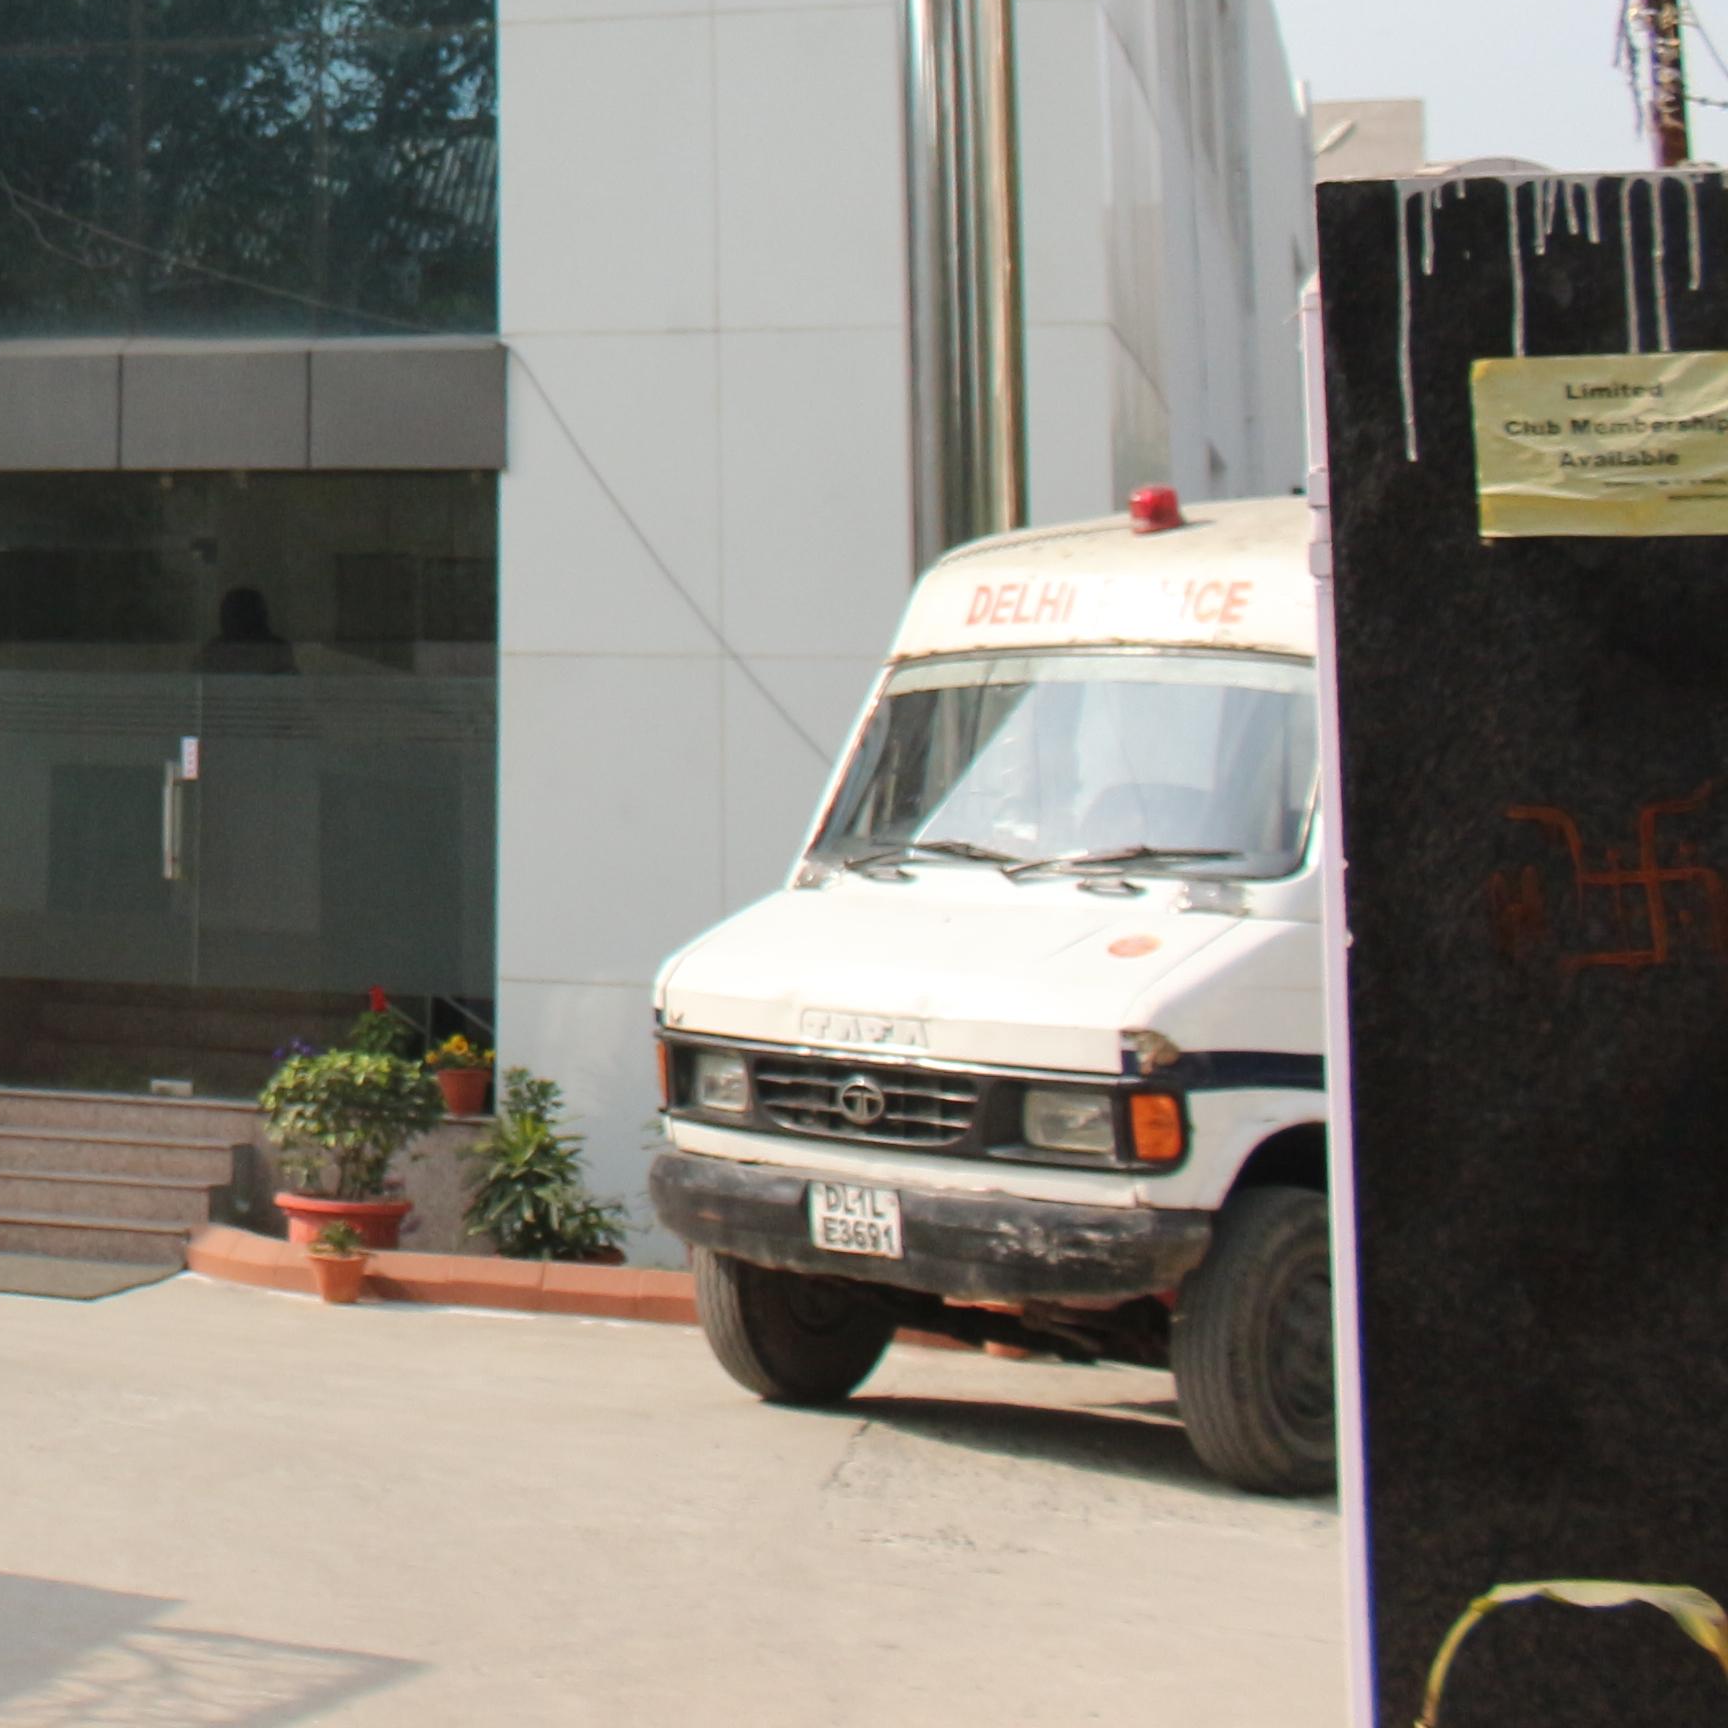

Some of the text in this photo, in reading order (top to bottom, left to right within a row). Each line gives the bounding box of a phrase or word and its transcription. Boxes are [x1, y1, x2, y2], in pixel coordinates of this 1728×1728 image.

[1565, 382, 1664, 400] Limited
[1503, 419, 1562, 436] Club
[1559, 449, 1681, 468] Available
[965, 581, 1077, 625] DELHI
